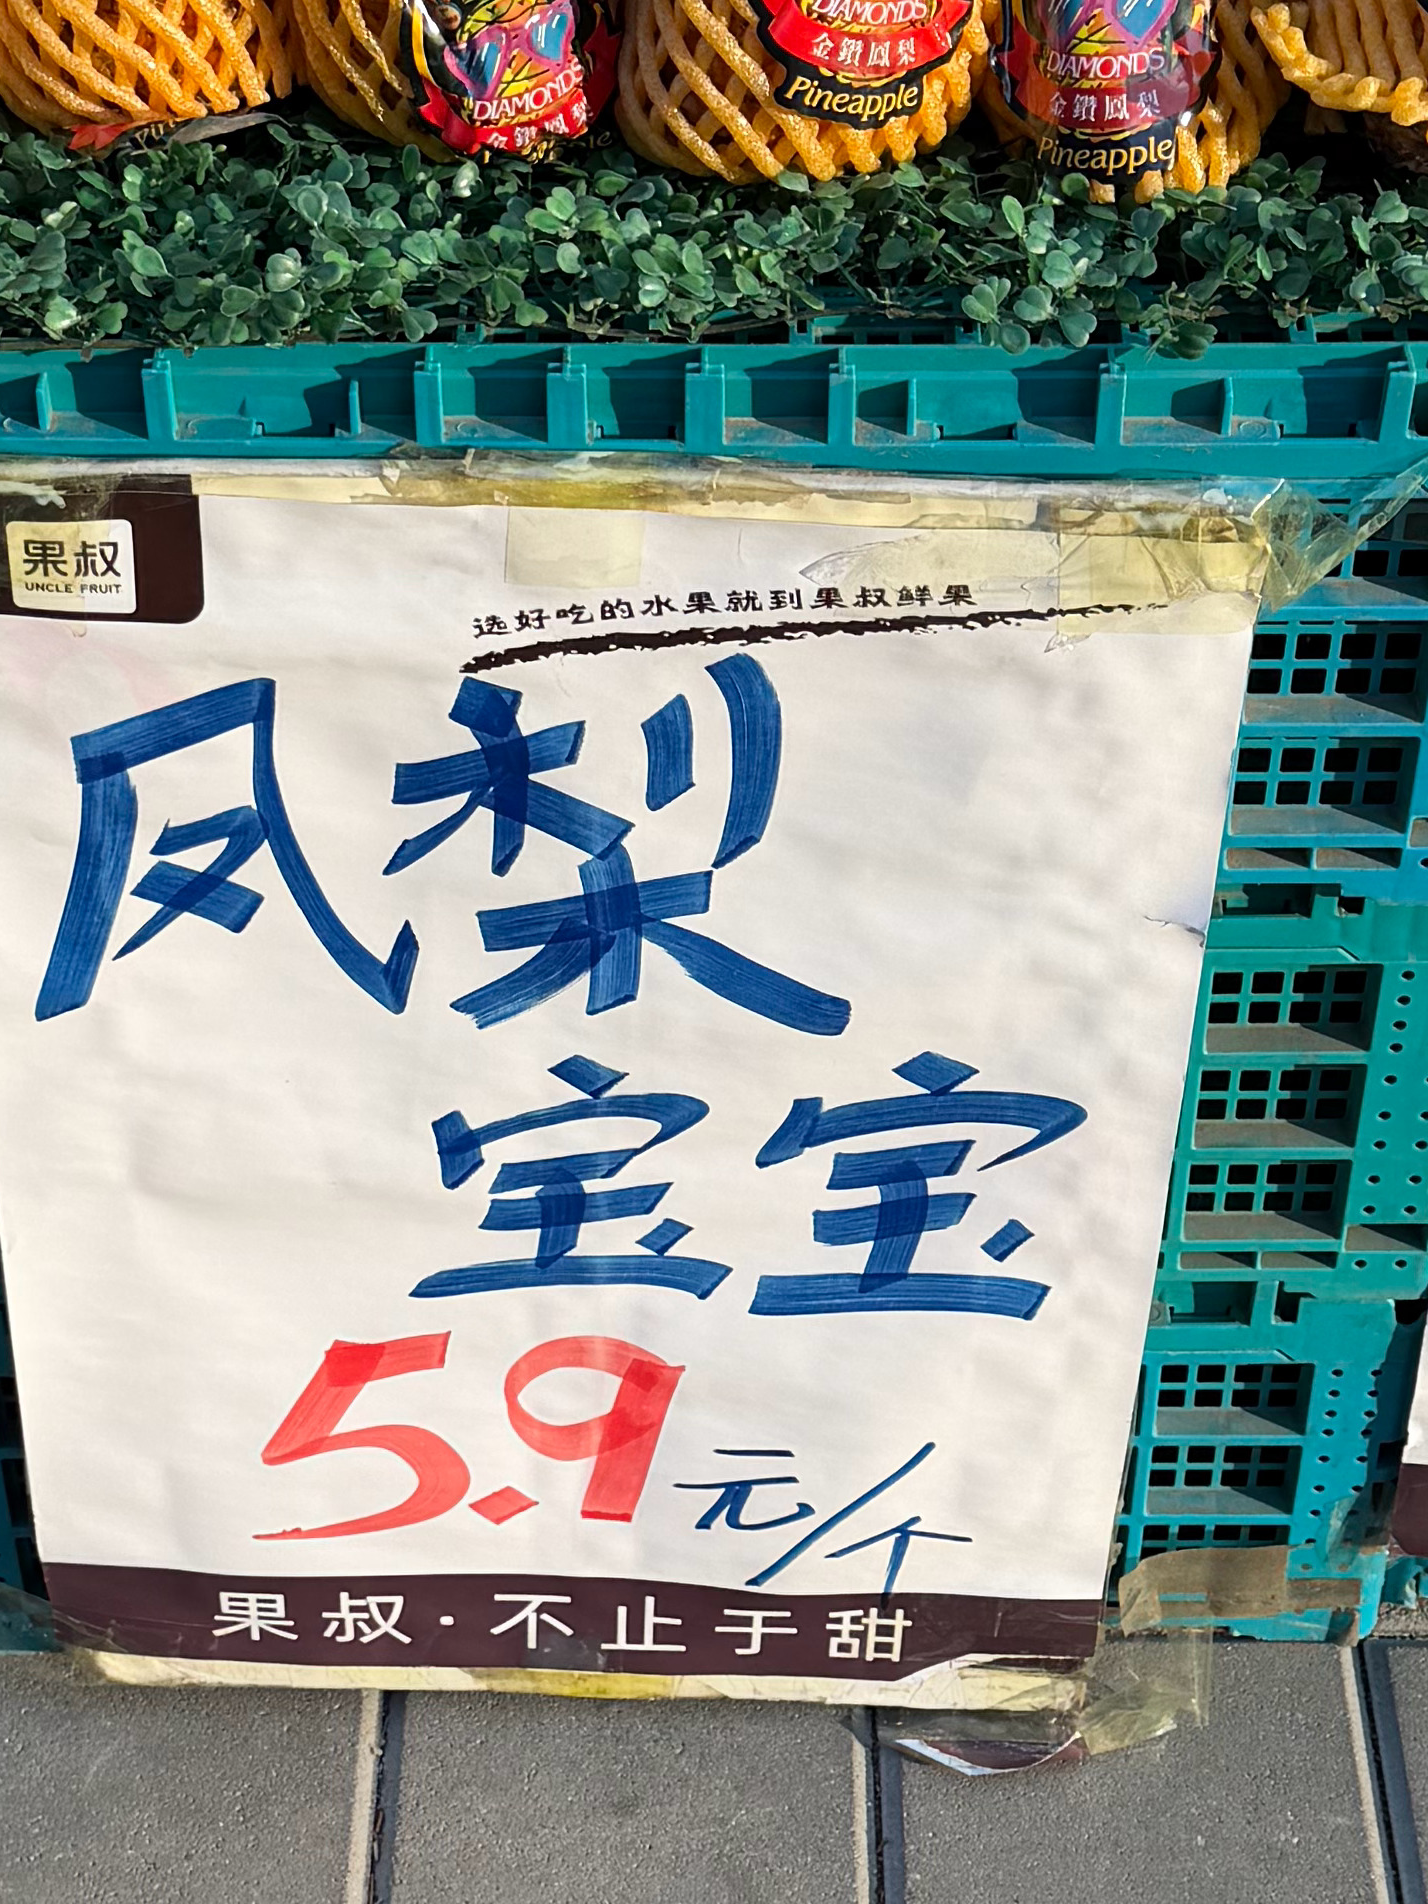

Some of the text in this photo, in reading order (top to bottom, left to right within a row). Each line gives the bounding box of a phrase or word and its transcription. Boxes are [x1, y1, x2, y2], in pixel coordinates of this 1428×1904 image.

[1046, 47, 1166, 80] DIAMONDS
[784, 75, 920, 122] Pineapple
[1036, 136, 1175, 176] Pineapple
[22, 539, 122, 578] 果叔
[24, 581, 122, 594] UNCLE FRUIT
[473, 583, 979, 639] 选好吃的水果就到果叔鲜果
[35, 653, 852, 1036] 凤梨
[408, 1051, 1088, 1321] 宝宝
